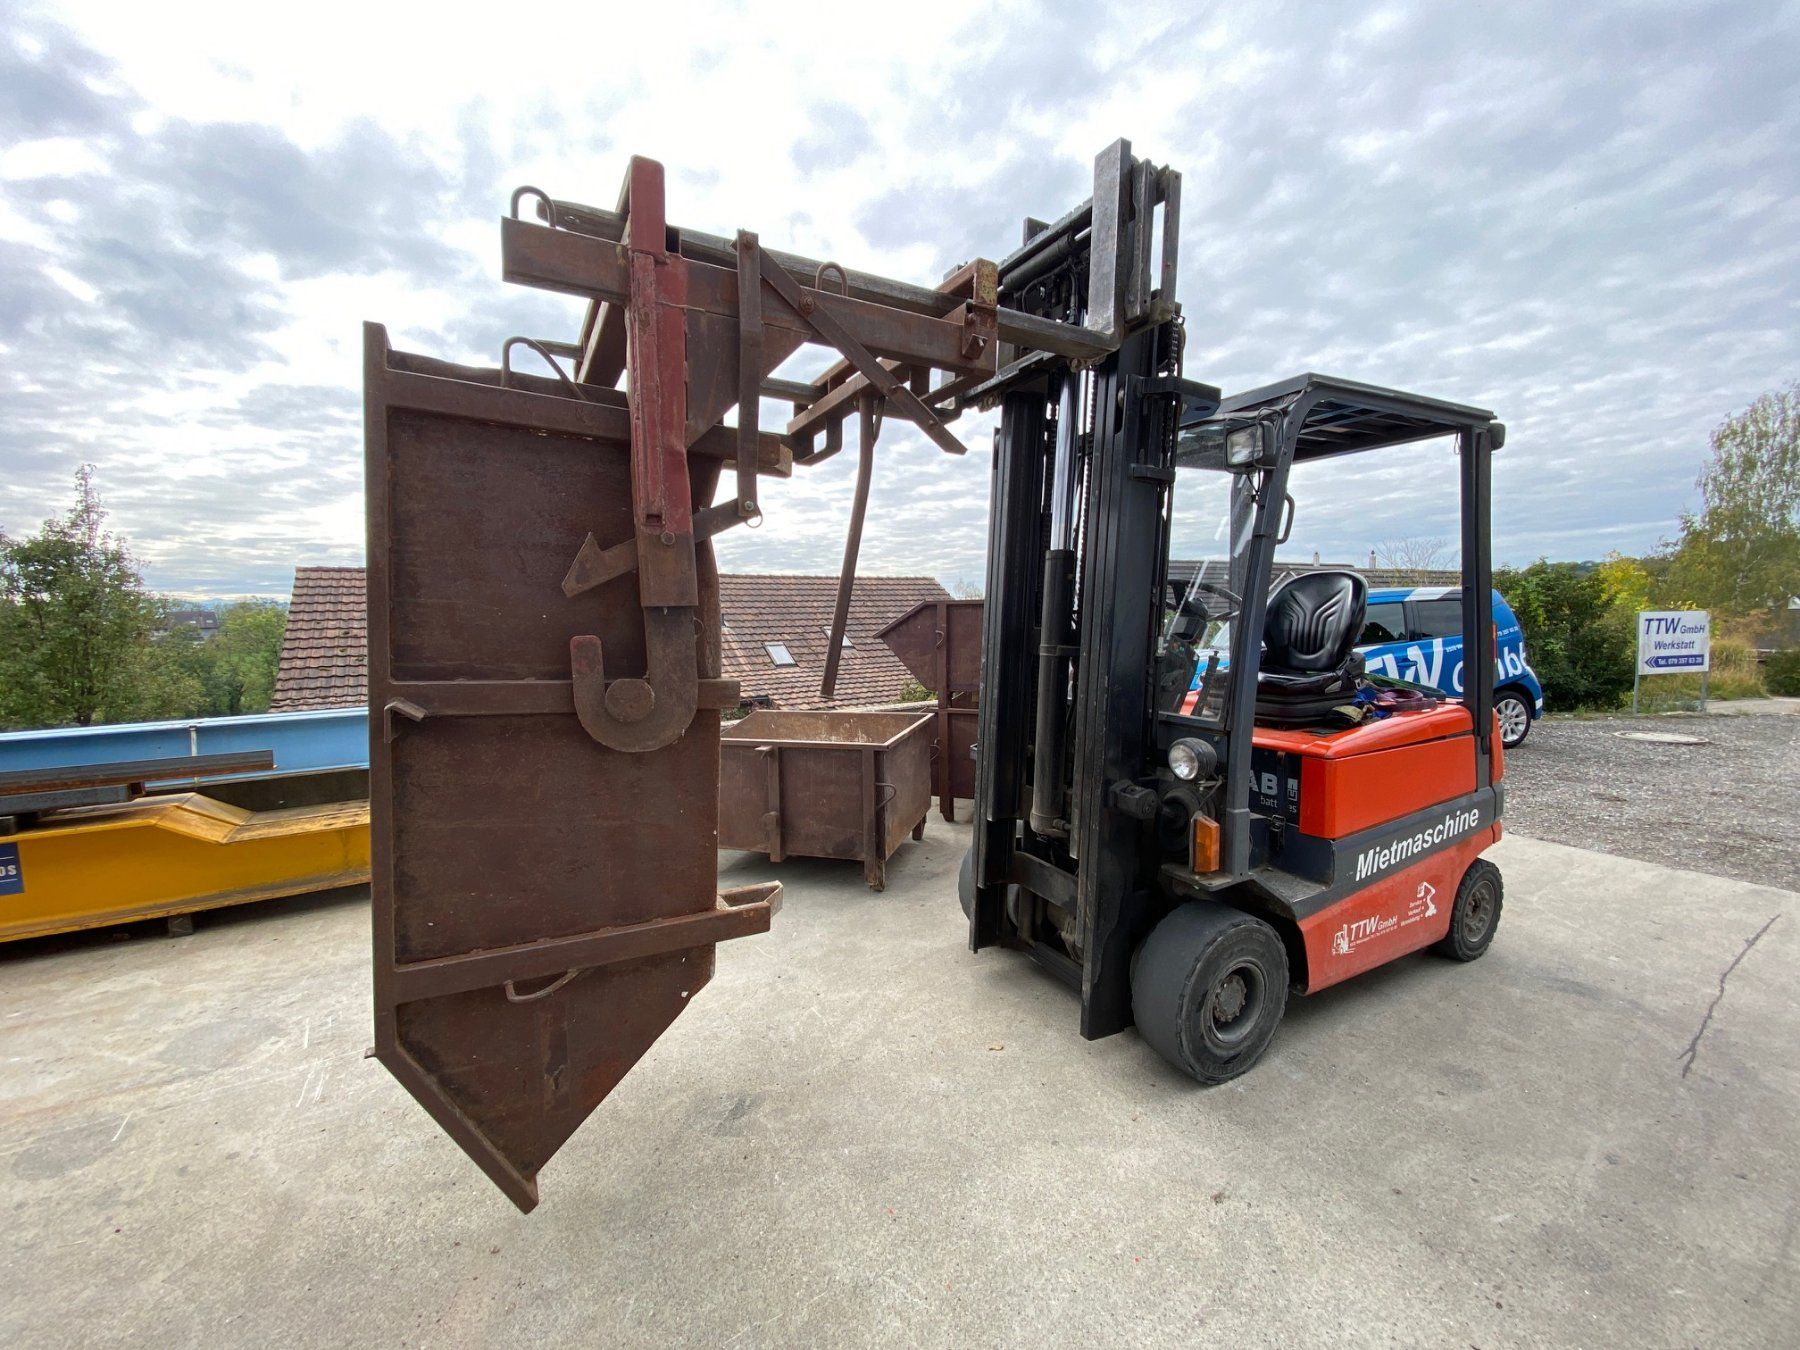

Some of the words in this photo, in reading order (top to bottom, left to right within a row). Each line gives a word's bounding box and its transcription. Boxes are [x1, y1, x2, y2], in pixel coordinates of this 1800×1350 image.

[1645, 618, 1681, 634] TTW
[1680, 624, 1705, 633] GmbH
[1654, 640, 1695, 650] Werkstatt
[1355, 808, 1479, 882] Mietmaschine
[1350, 914, 1379, 941] TTW
[1378, 915, 1398, 930] GmbH
